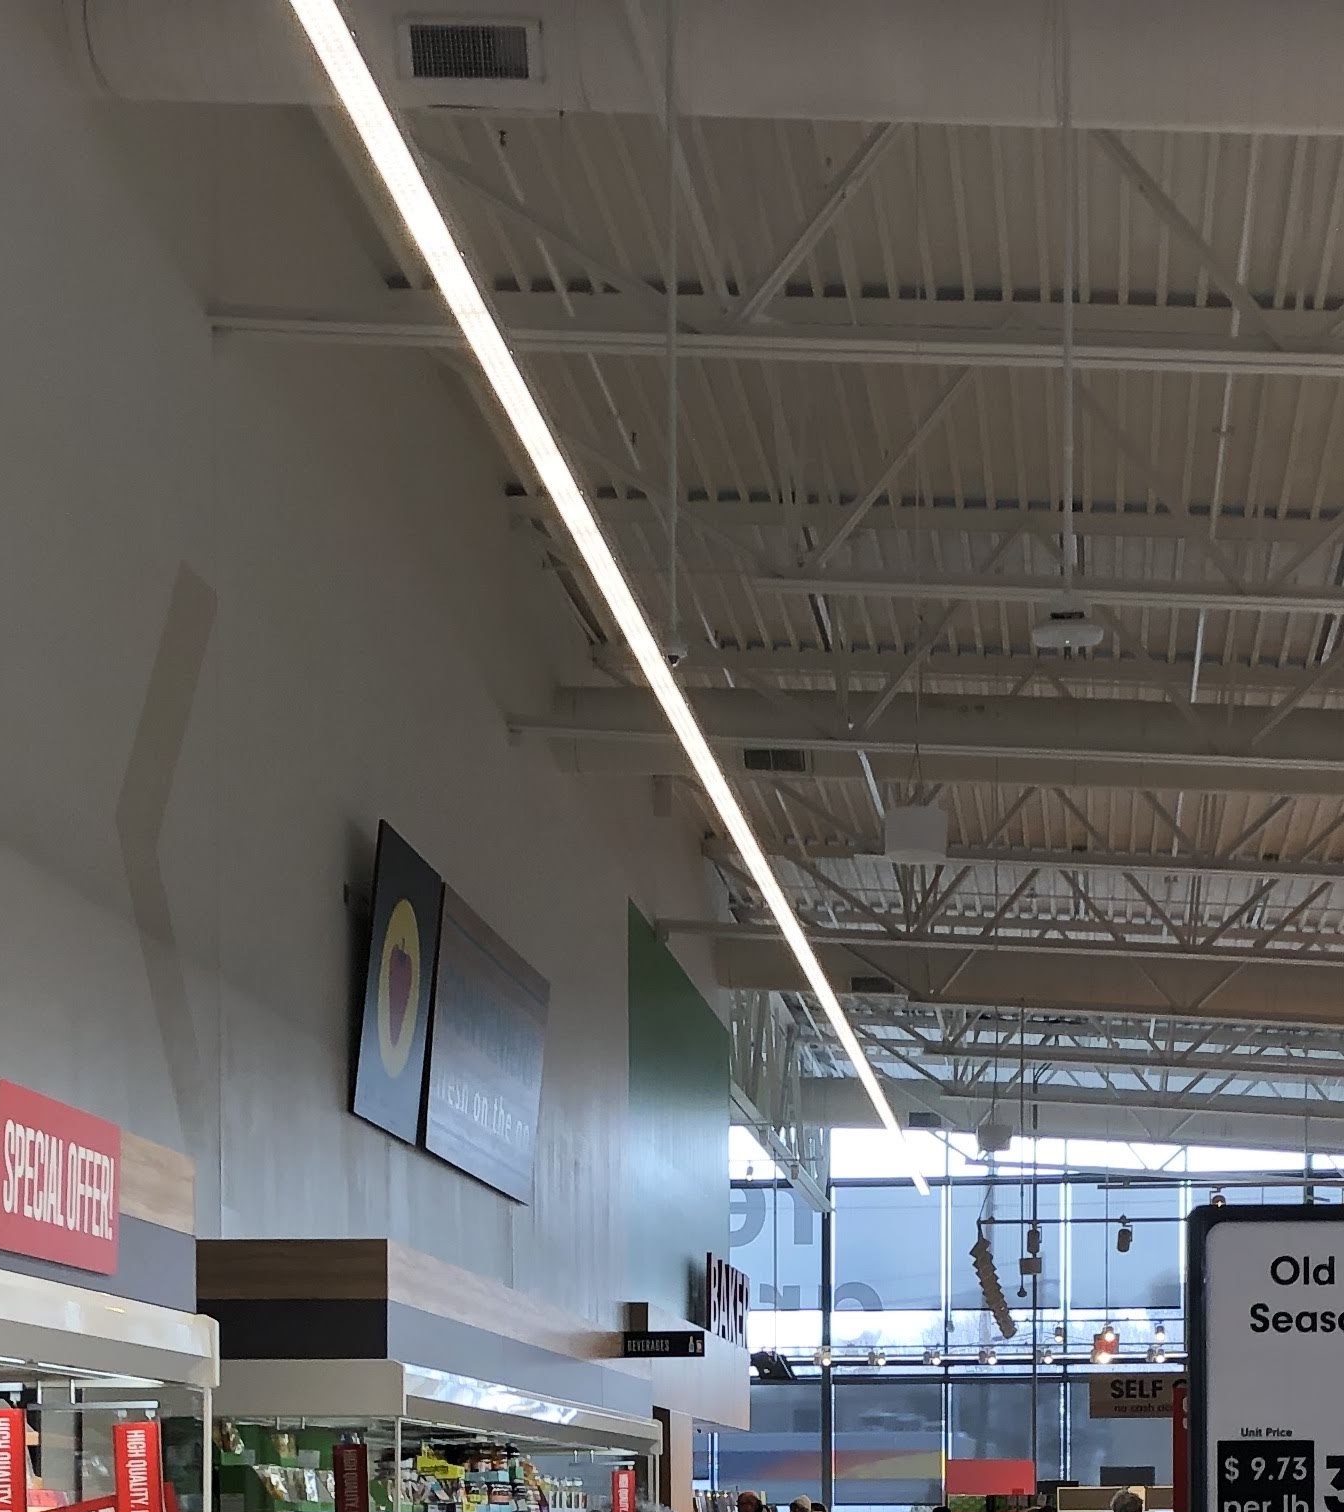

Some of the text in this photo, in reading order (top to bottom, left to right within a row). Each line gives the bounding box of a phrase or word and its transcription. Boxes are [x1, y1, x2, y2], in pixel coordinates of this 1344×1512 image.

[2, 1118, 114, 1241] SPECIAL OFFER!
[1270, 1255, 1336, 1286] Old
[1110, 1378, 1164, 1399] SELF
[126, 1429, 147, 1457] HIGH
[1240, 1427, 1293, 1438] Unit Price
[1224, 1456, 1307, 1482] $ 9.73
[126, 1460, 149, 1508] QUALITY.
